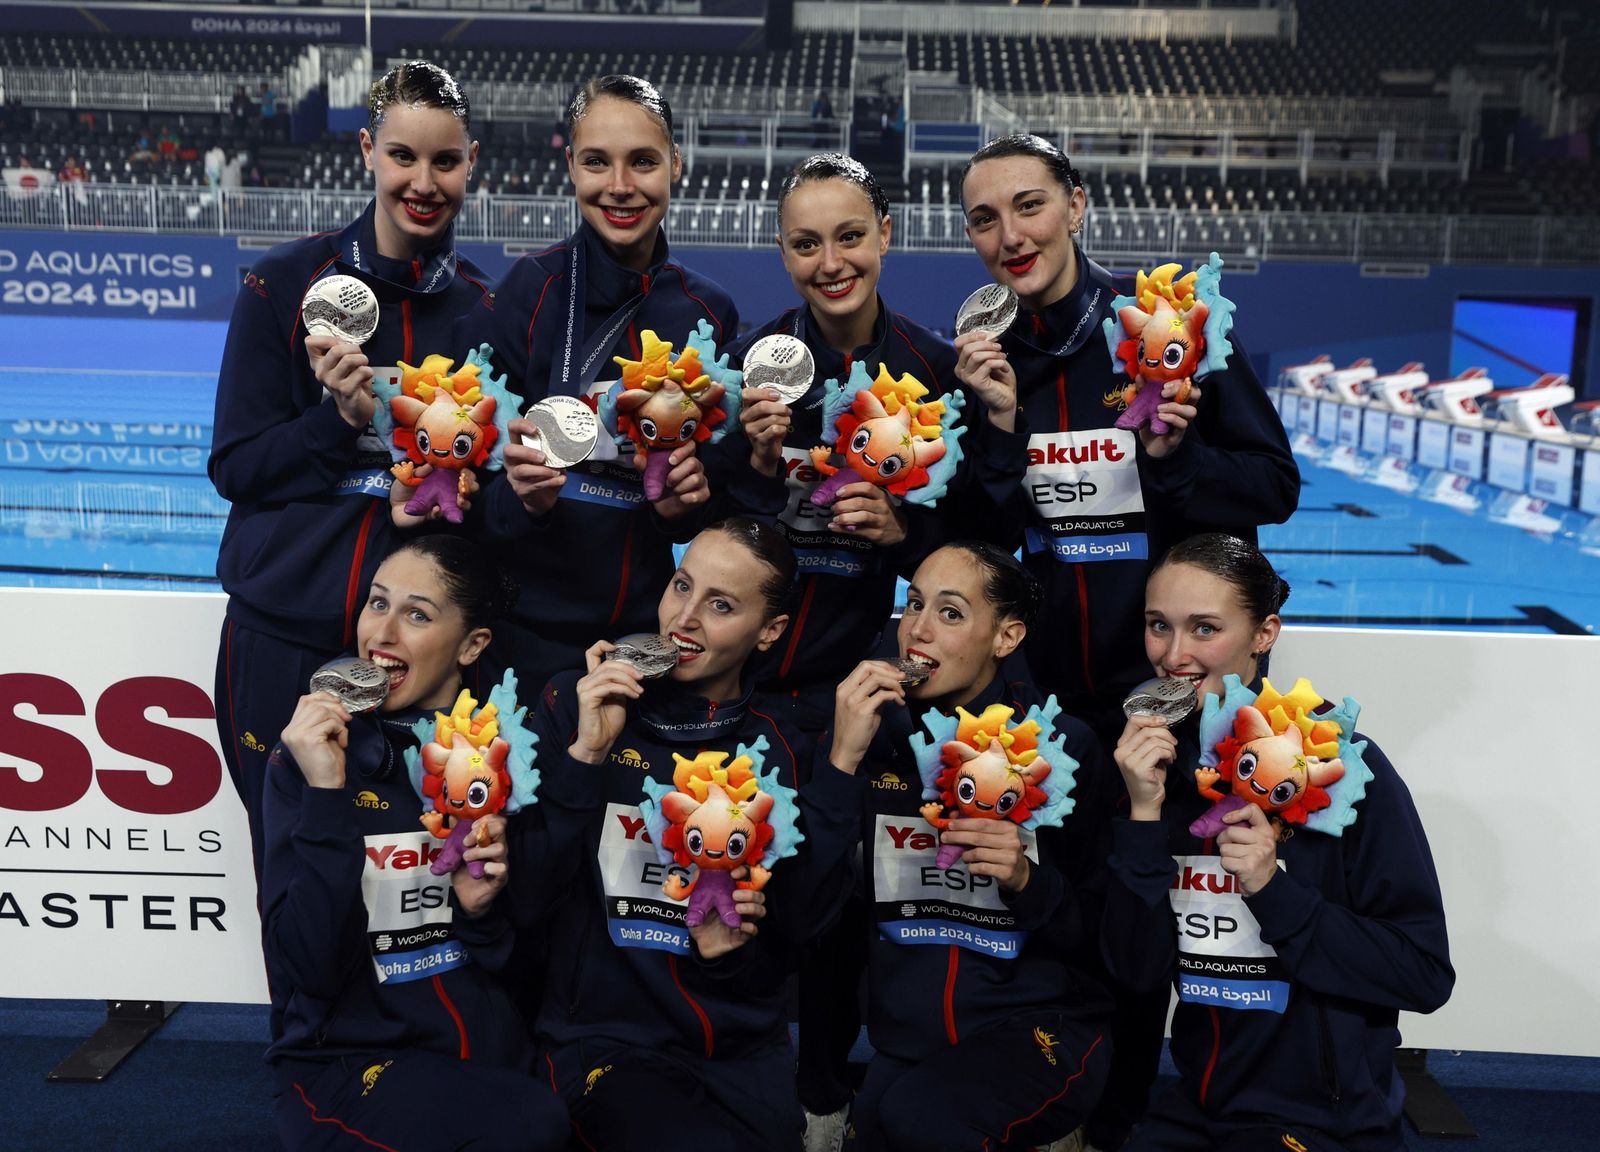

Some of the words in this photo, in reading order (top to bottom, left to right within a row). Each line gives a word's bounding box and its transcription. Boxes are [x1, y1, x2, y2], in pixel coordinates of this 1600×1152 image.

[192, 18, 243, 32] DOHA
[246, 19, 292, 33] 2024
[294, 18, 341, 37] الدوحة
[26, 251, 195, 277] AQUATICS
[314, 280, 329, 292] DOHA
[3, 280, 98, 305] 2024
[103, 279, 196, 315] الدوحة
[1088, 288, 1102, 313] WORLD
[566, 296, 576, 348] CHAMPIONSHIPS
[1066, 312, 1090, 346] AQUATICS
[565, 399, 580, 407] 2024
[580, 482, 614, 498] Doha
[1031, 481, 1097, 504] ESP
[1052, 522, 1074, 532] RLD
[1074, 520, 1125, 530] AQUATICS
[788, 532, 822, 544] WORLD
[1090, 541, 1130, 556] الدوحة
[797, 556, 827, 566] 2024
[683, 721, 722, 731] AQUATICS
[610, 753, 650, 770] TURBO
[871, 780, 908, 791] TURBO
[5, 825, 222, 853] ANNELS
[920, 866, 992, 893] ESP
[0, 892, 227, 932] ASTER
[633, 904, 674, 919] WORLD
[920, 905, 960, 917] WORLD
[961, 911, 1015, 925] AQUATICS
[397, 931, 431, 945] WORLD
[620, 928, 642, 940] Doha
[644, 929, 680, 946] 2024
[901, 927, 936, 938] Doha
[939, 926, 973, 942] 2024
[975, 934, 1016, 952] الدوحة
[414, 956, 443, 972] 2024
[1205, 963, 1267, 974] AQUATICS
[1182, 982, 1219, 998] 2024
[1222, 987, 1271, 1005] الدوحة
